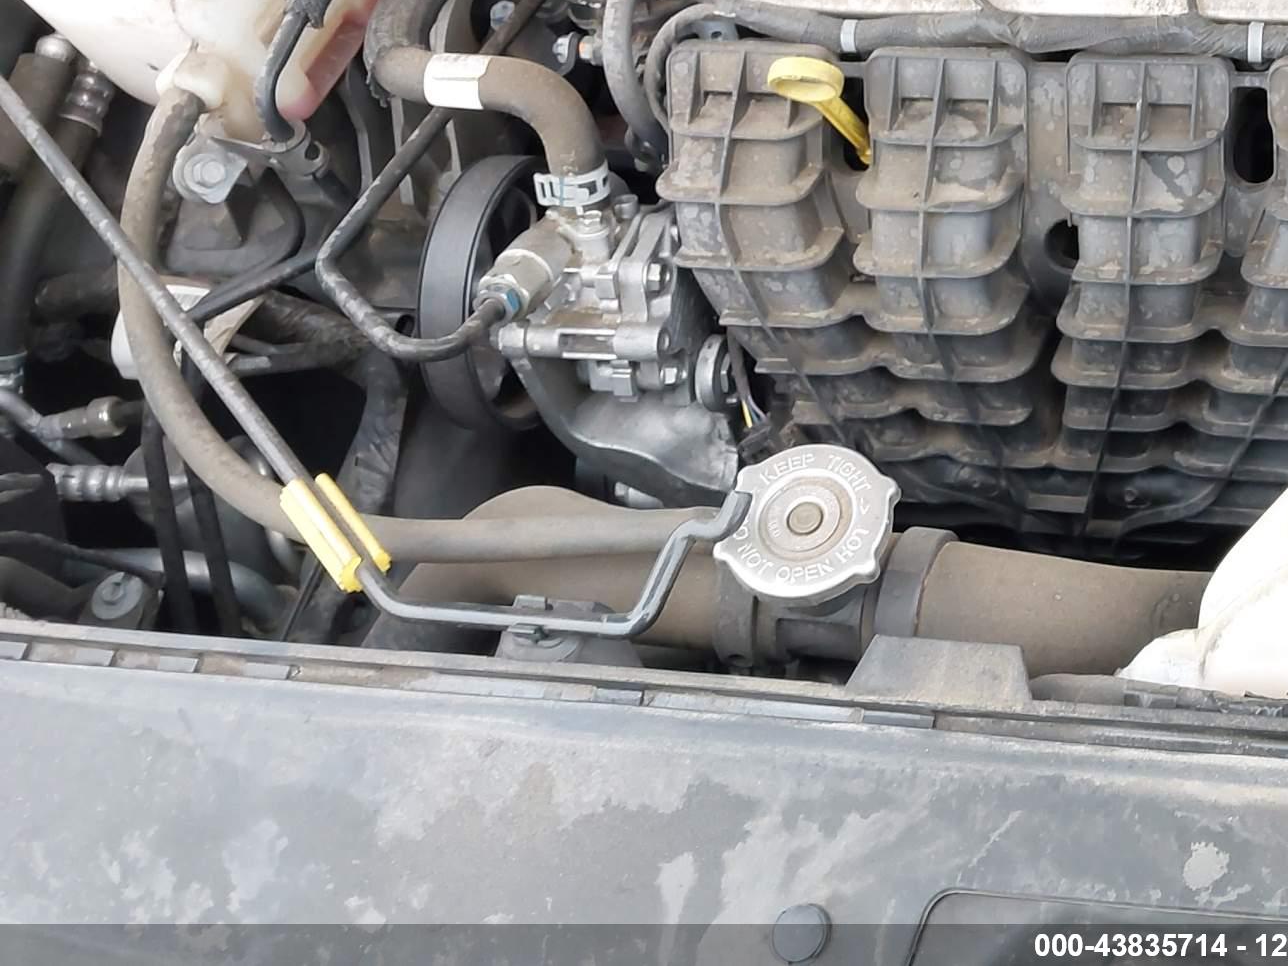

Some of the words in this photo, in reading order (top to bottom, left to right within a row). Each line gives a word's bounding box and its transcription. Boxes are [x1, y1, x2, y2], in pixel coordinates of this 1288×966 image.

[759, 453, 815, 485] KEEP
[824, 454, 873, 492] TIGHT
[737, 543, 773, 575] NOT
[775, 559, 835, 583] OPEN
[836, 528, 871, 563] HOT
